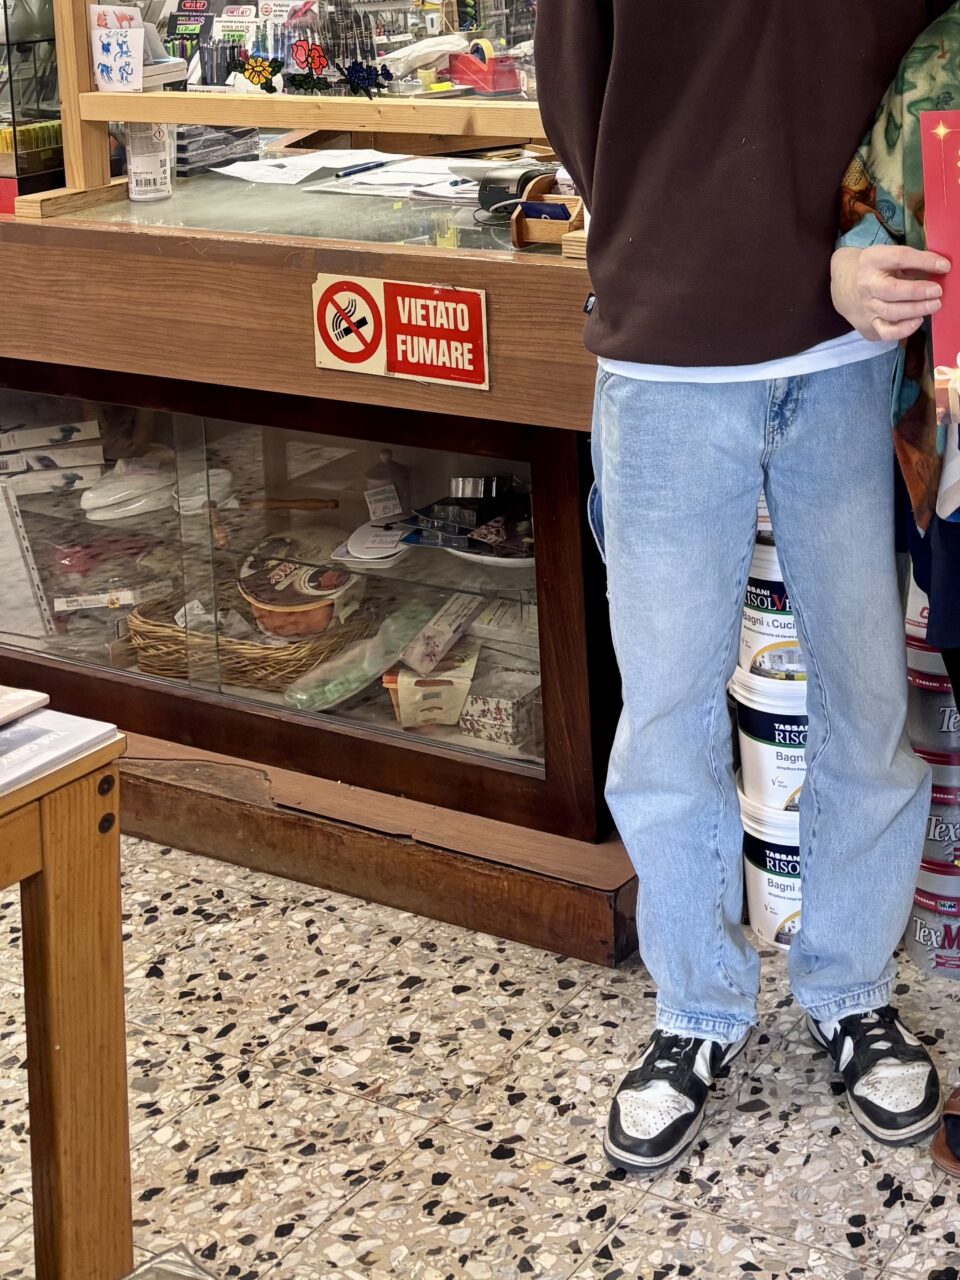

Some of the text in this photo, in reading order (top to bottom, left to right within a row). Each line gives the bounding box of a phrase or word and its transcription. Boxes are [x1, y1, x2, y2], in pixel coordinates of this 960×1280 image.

[396, 296, 470, 332] VIETATO
[396, 334, 474, 371] FUMARE
[746, 585, 770, 597] SSANI
[742, 611, 764, 627] Bagni
[772, 619, 796, 630] Cuci
[939, 707, 960, 733] Te
[775, 731, 809, 745] RISO
[776, 751, 803, 764] Bagn
[765, 850, 800, 862] TASSAN
[766, 857, 801, 875] RISO
[767, 878, 795, 892] Bagni
